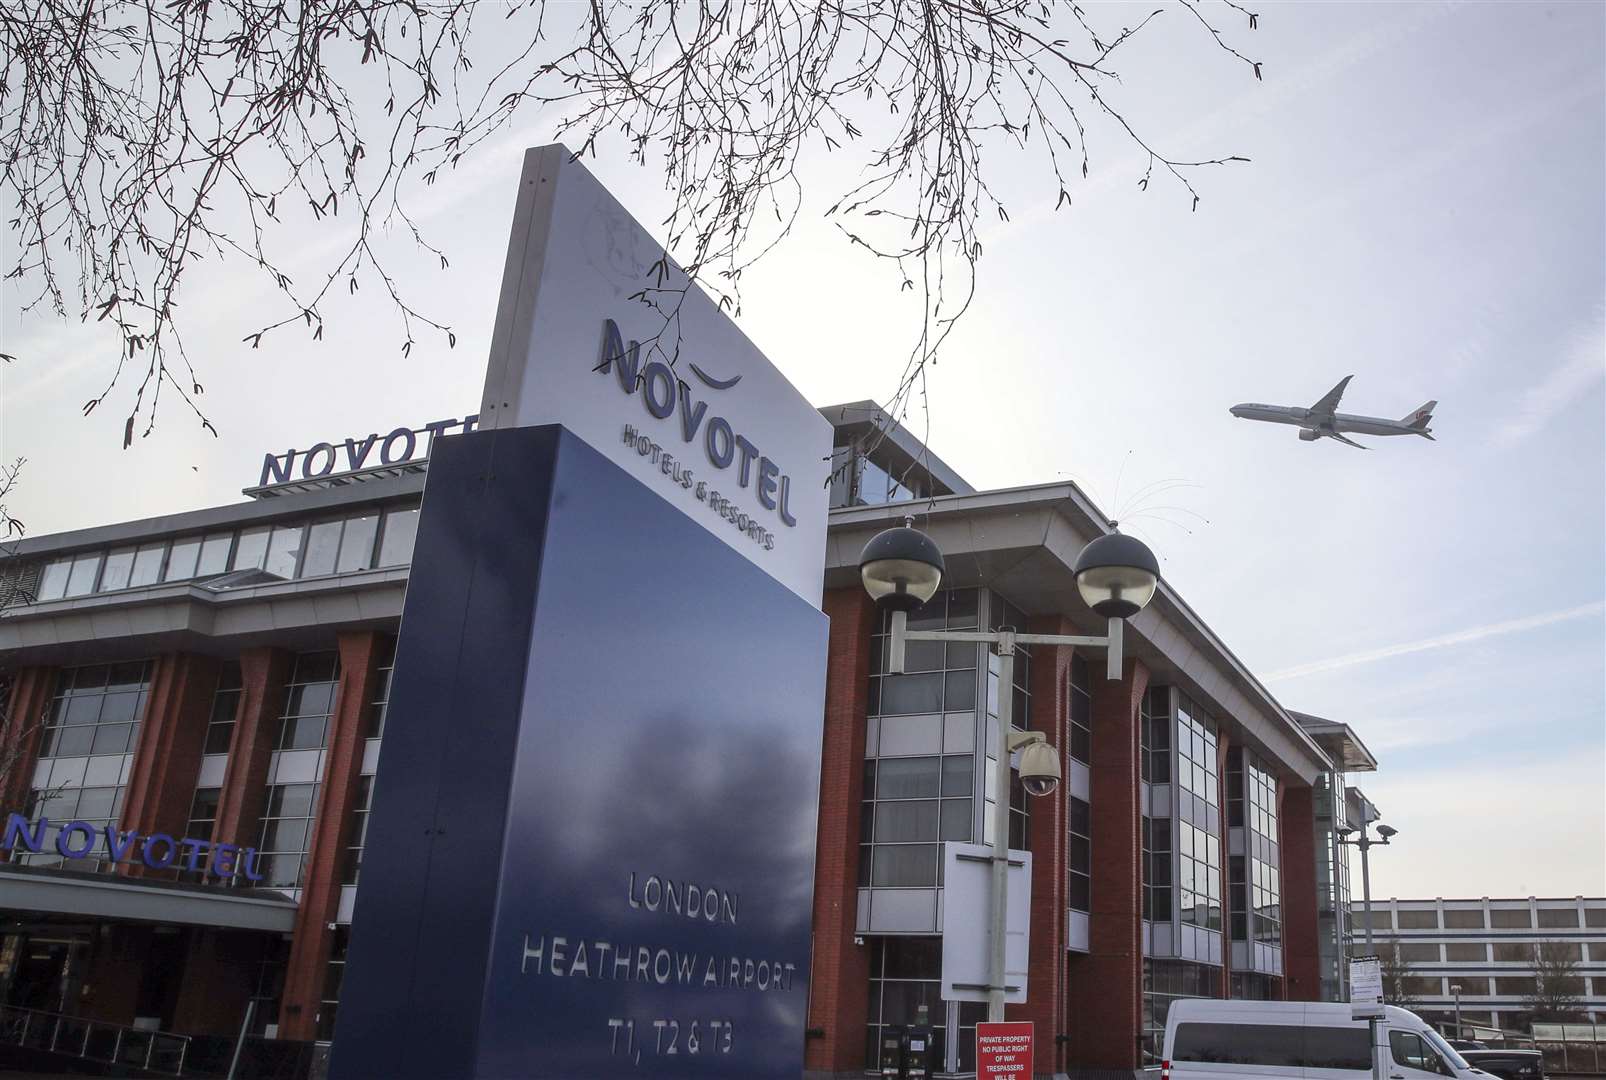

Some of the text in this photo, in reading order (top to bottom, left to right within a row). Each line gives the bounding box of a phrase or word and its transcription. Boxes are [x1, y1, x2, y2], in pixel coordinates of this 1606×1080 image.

[597, 318, 797, 527] NOVOTEL
[624, 423, 775, 551] HOTELS & RESORTS
[2, 811, 264, 881] NOVOTEL
[627, 871, 738, 925] LONDON
[521, 935, 796, 992] HEATHROW AIRPORT
[608, 1018, 733, 1066] T1, T2 & T3
[986, 1064, 1025, 1072] TRESPASSERS
